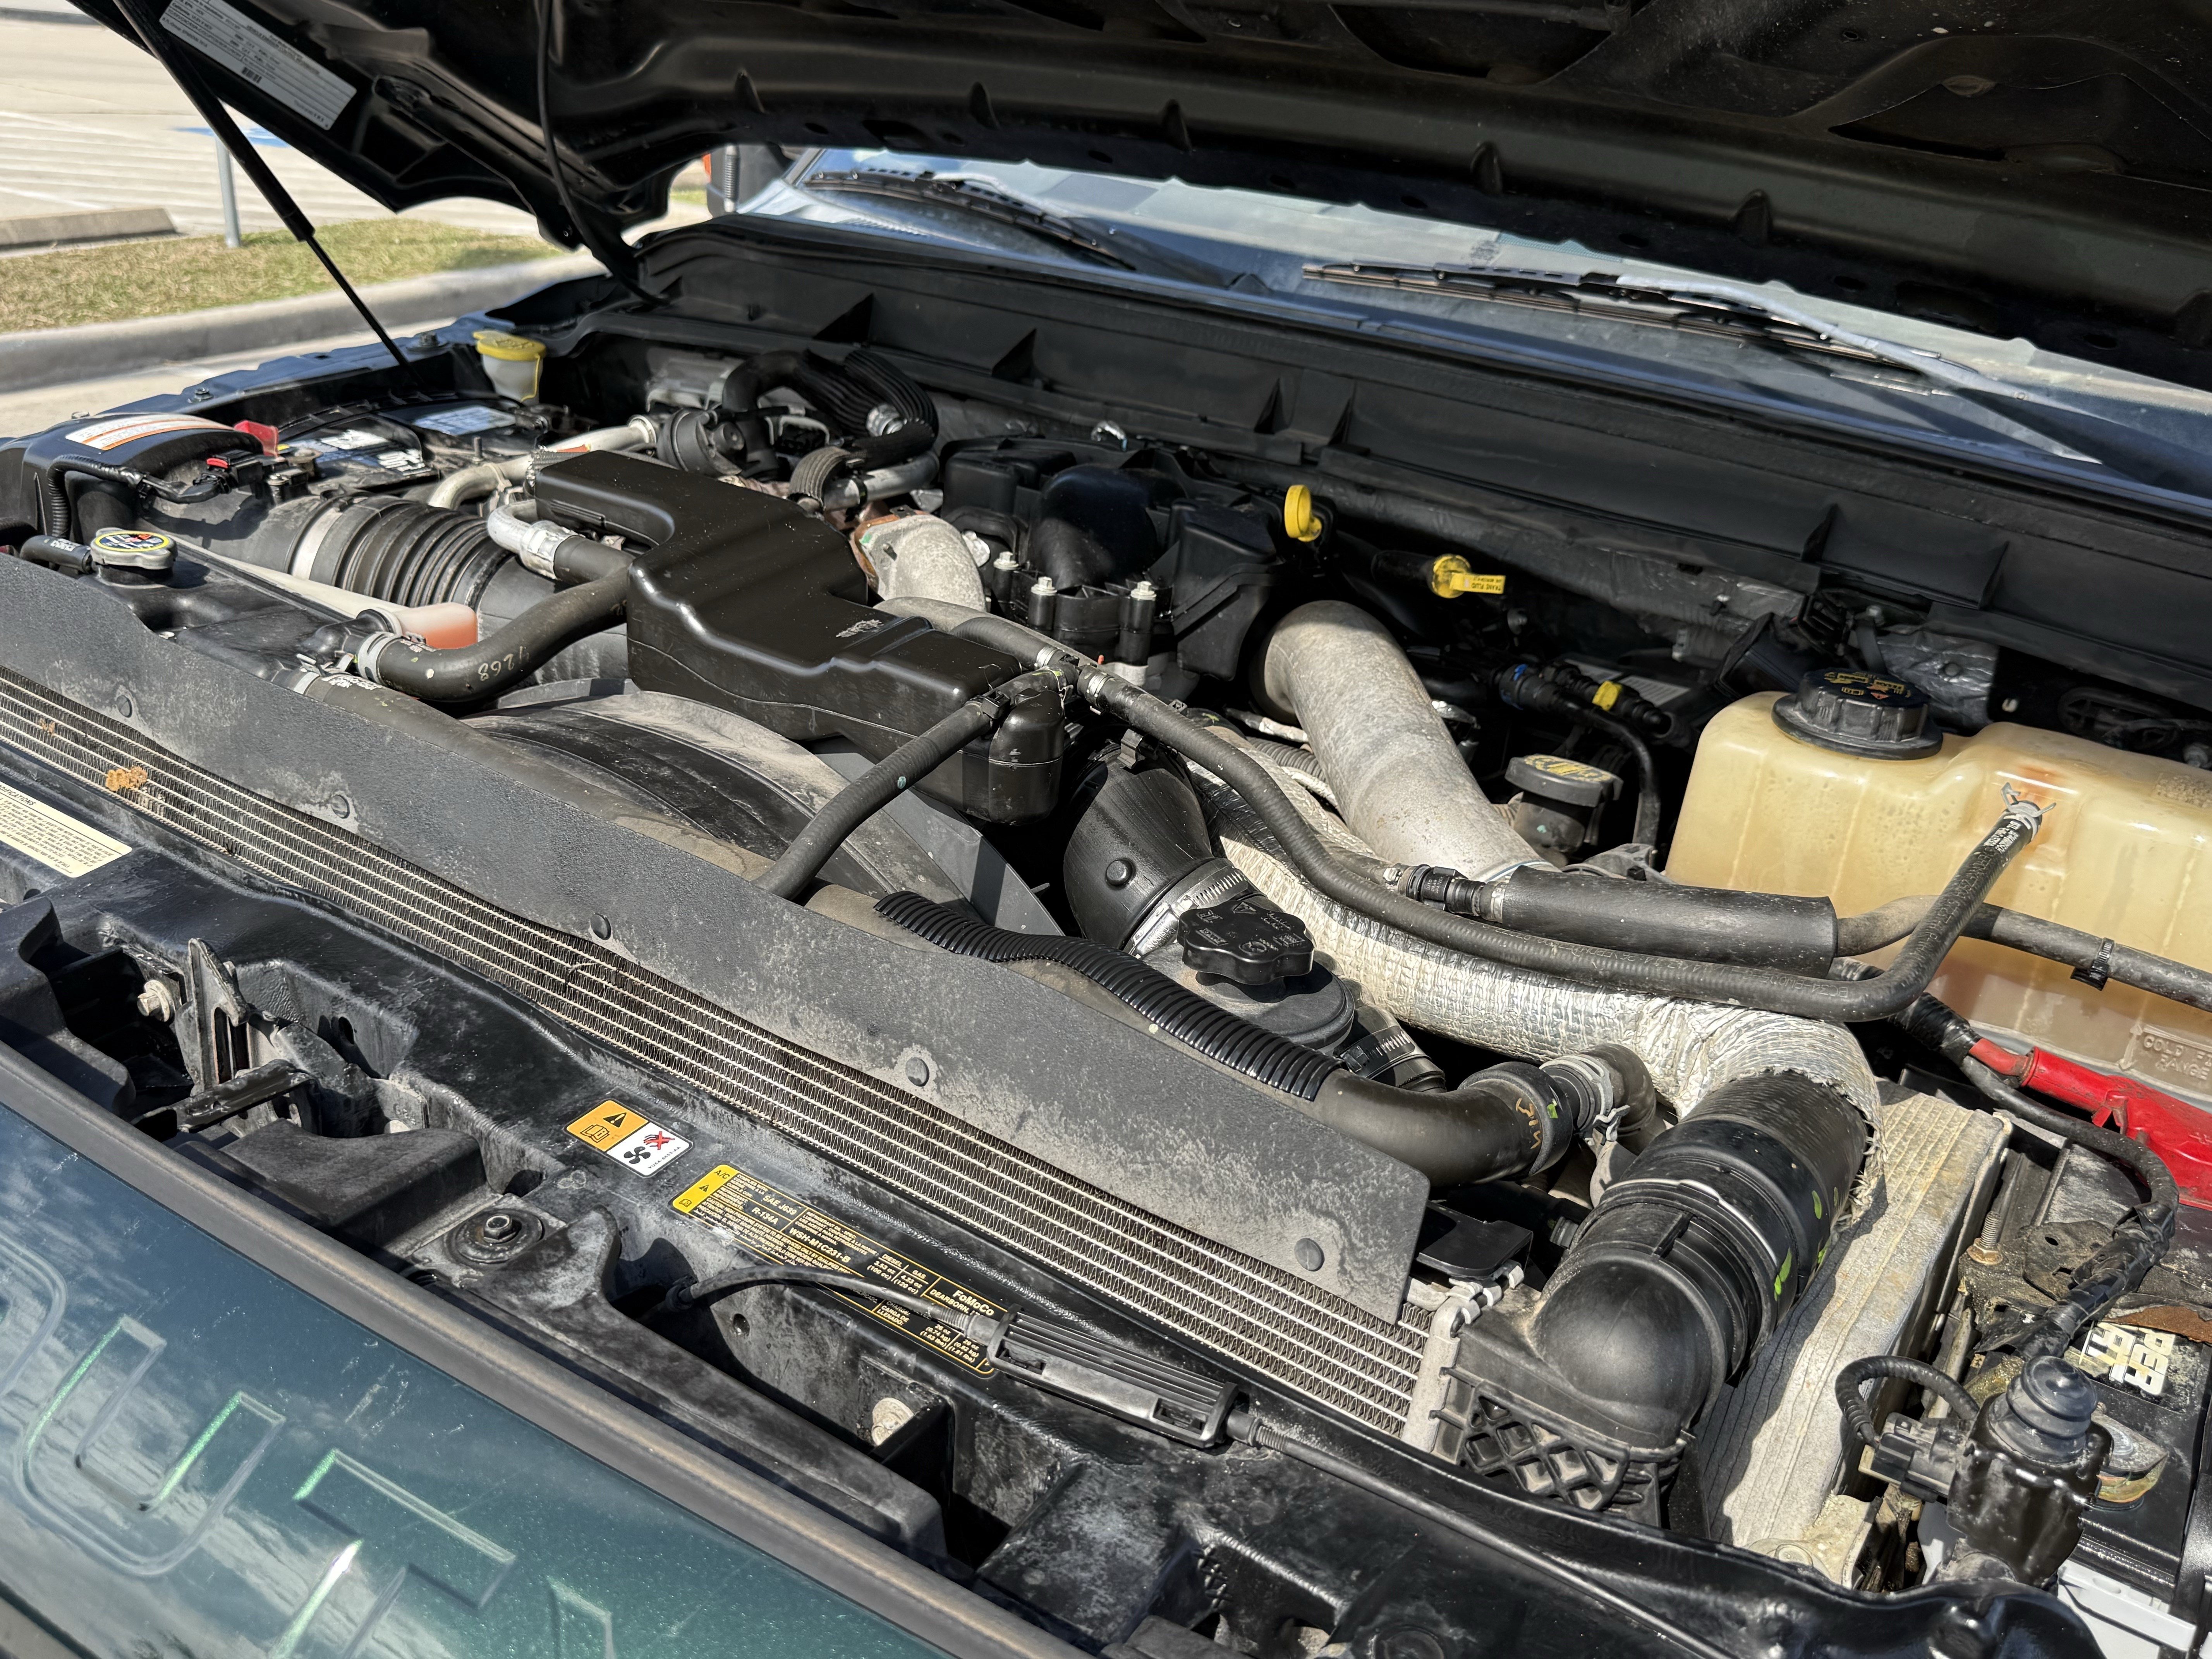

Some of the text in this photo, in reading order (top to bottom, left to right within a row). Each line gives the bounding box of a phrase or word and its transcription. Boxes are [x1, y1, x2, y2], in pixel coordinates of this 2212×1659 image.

[2143, 1034, 2183, 1057] COLD
[2155, 1053, 2209, 1080] RANGE
[714, 1168, 730, 1180] A/C
[762, 1195, 797, 1214] SAE J639
[751, 1207, 779, 1223] R-134A
[788, 1228, 850, 1262] WSH-M1C231-B
[867, 1264, 891, 1280] (100 cc)
[874, 1261, 887, 1269] 3.53
[881, 1254, 926, 1279] DIESEL GAS
[893, 1279, 918, 1294] (120 cc)
[900, 1274, 914, 1283] 4.23
[929, 1288, 969, 1313] DEARBORN,
[952, 1289, 994, 1316] FoMoCo
[877, 1309, 903, 1325] LLENADO:
[881, 1305, 900, 1317] CARGA
[925, 1326, 940, 1336] (0.74
[968, 1349, 978, 1357] kg)
